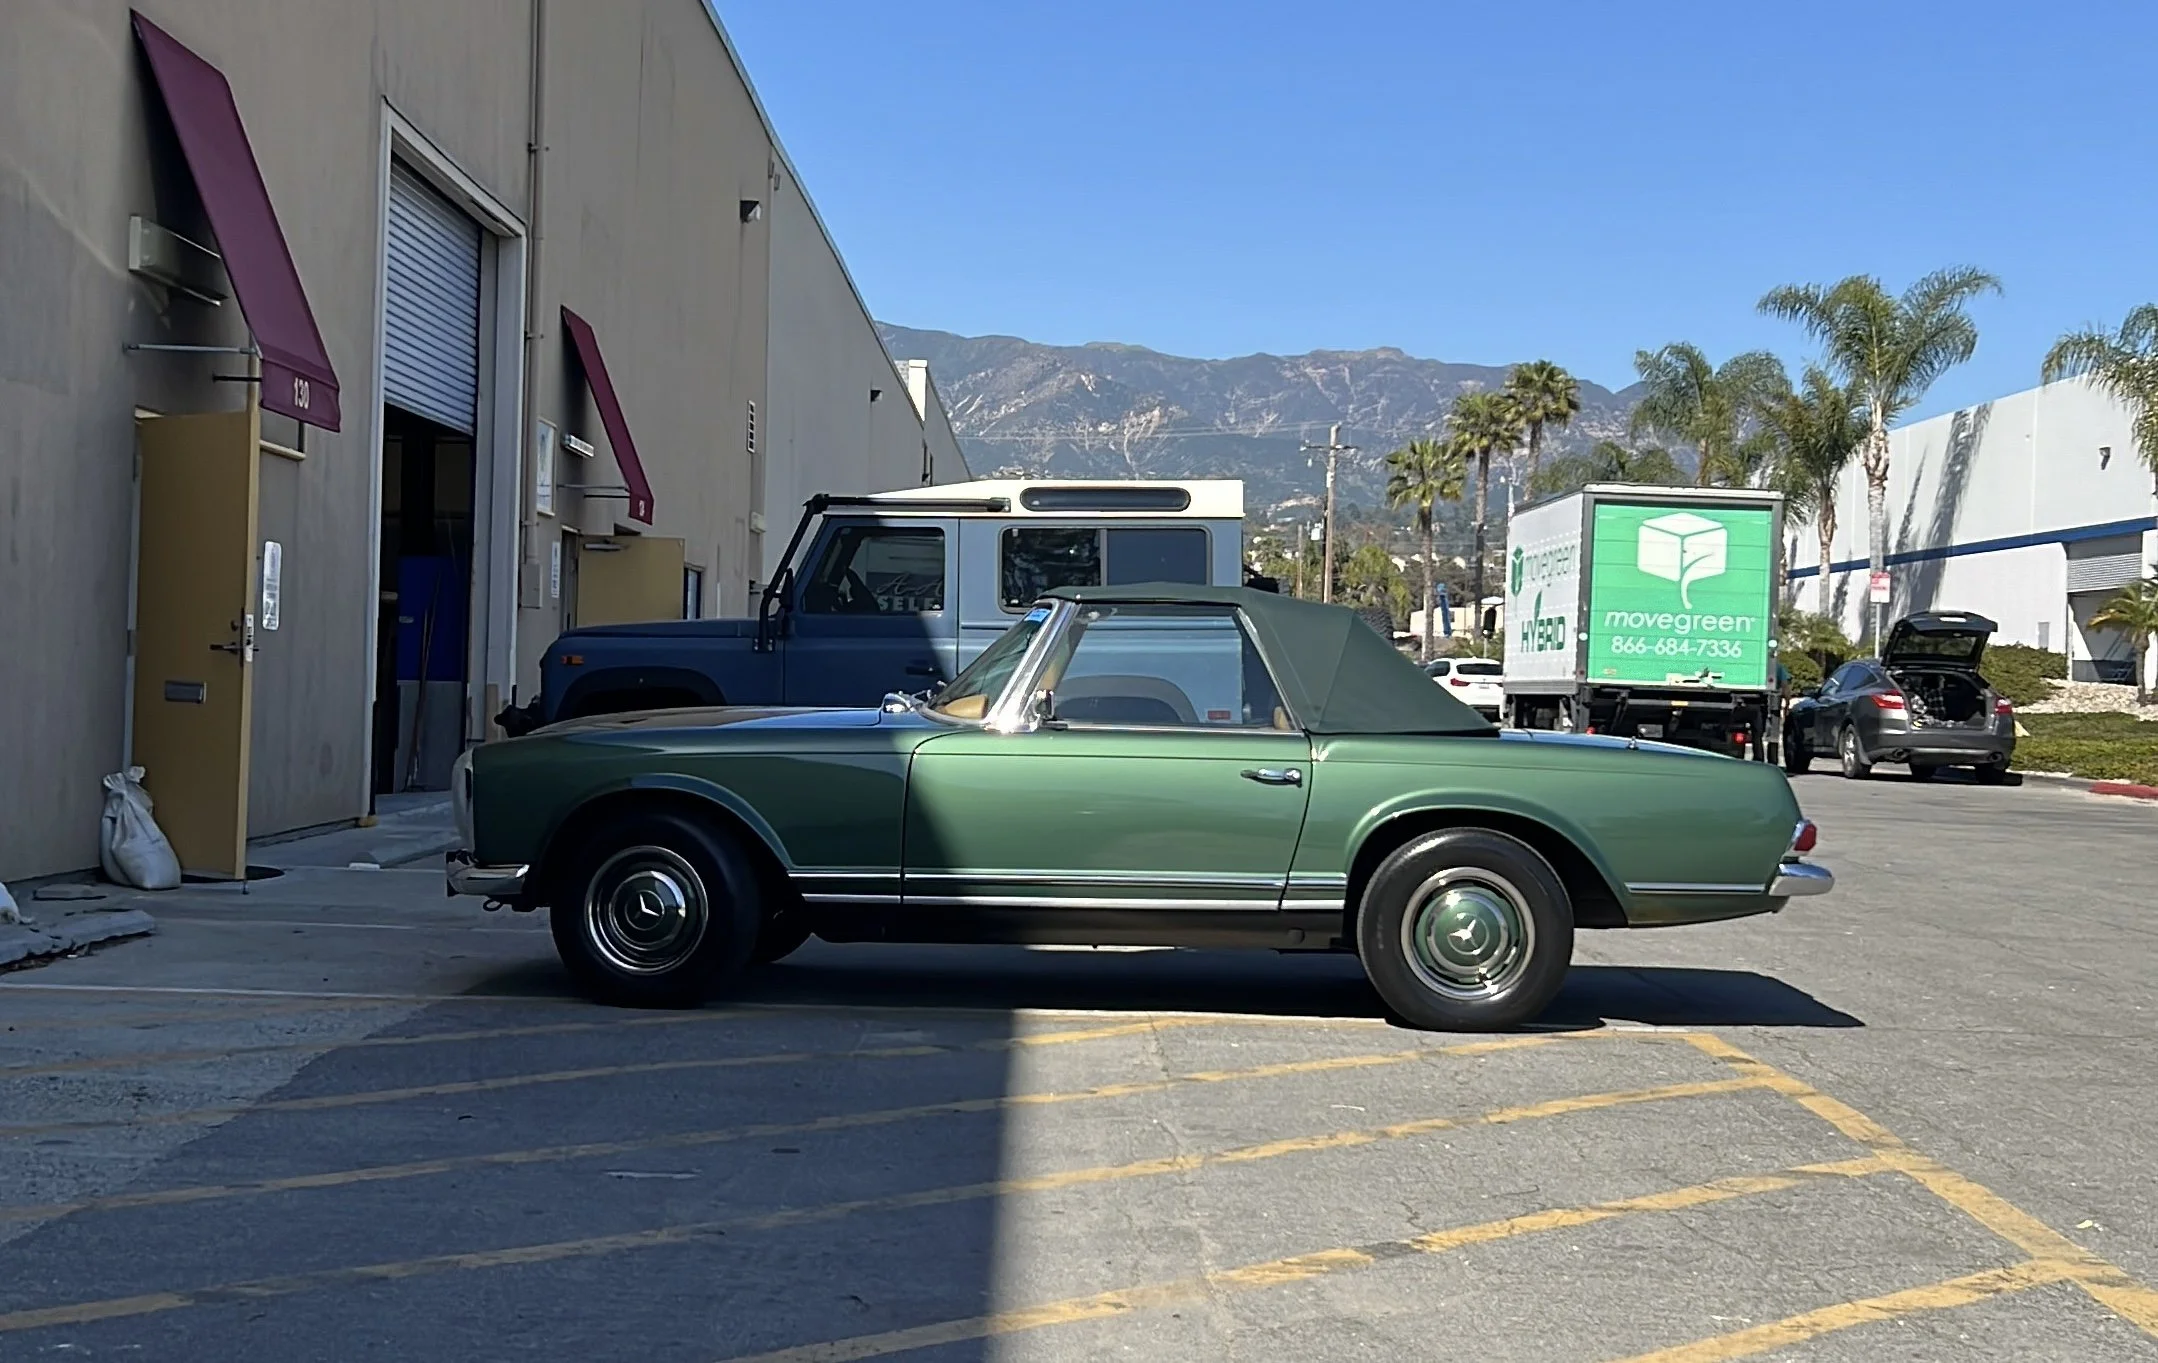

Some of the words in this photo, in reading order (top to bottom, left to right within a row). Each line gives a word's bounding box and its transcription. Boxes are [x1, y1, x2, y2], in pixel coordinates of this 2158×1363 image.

[293, 376, 310, 410] 130
[1520, 616, 1566, 653] HYBRID
[1604, 611, 1752, 635] movegreen
[1611, 635, 1743, 658] 866-684-7336
